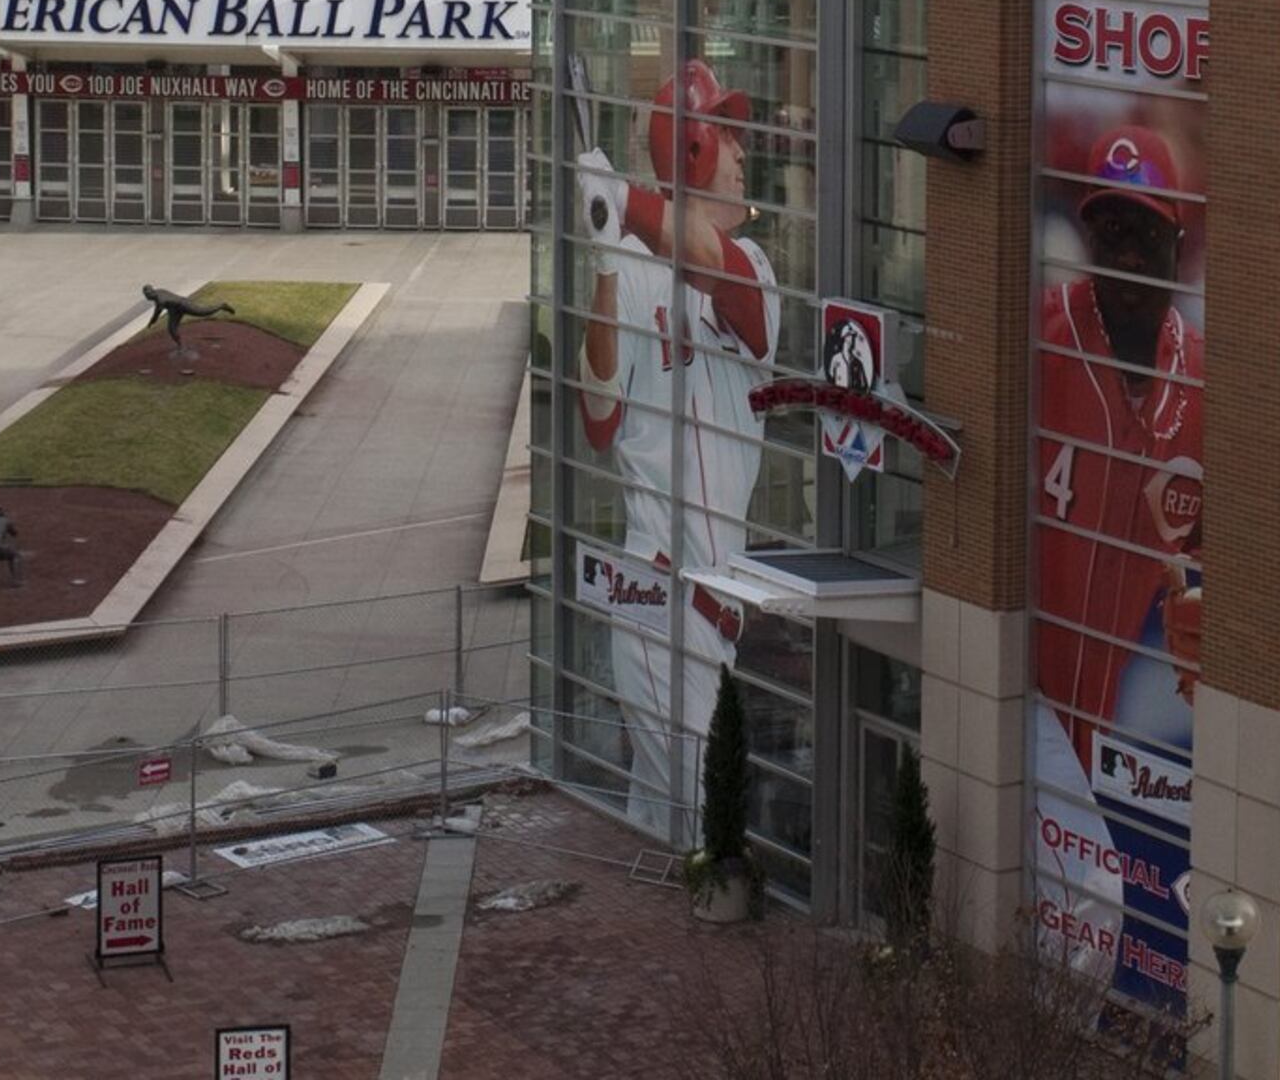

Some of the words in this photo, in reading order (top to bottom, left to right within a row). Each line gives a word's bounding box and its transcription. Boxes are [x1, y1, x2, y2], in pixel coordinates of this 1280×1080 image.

[25, 75, 55, 93] YOU
[88, 76, 114, 94] 100
[119, 76, 144, 95] JOE
[150, 76, 219, 97] NUXHALL
[224, 78, 257, 97] WAY
[306, 79, 351, 99] HOME
[356, 80, 375, 99] OF
[380, 80, 409, 100] THE
[416, 80, 505, 101] CINCINNATI
[510, 82, 531, 101] RE
[1045, 445, 1073, 519] 4
[1164, 489, 1202, 517] RED
[608, 572, 667, 606] Authentic
[1131, 766, 1192, 802] Authent
[1041, 818, 1169, 899] OFFICIAL
[111, 878, 149, 897] Hall
[120, 898, 140, 914] of
[104, 916, 156, 933] Fame
[1039, 899, 1116, 958] GEAR
[1121, 933, 1188, 993] HER
[224, 1035, 253, 1044] Visit
[229, 1046, 276, 1060] Reds
[224, 1062, 256, 1075] Hall
[265, 1061, 281, 1073] of
